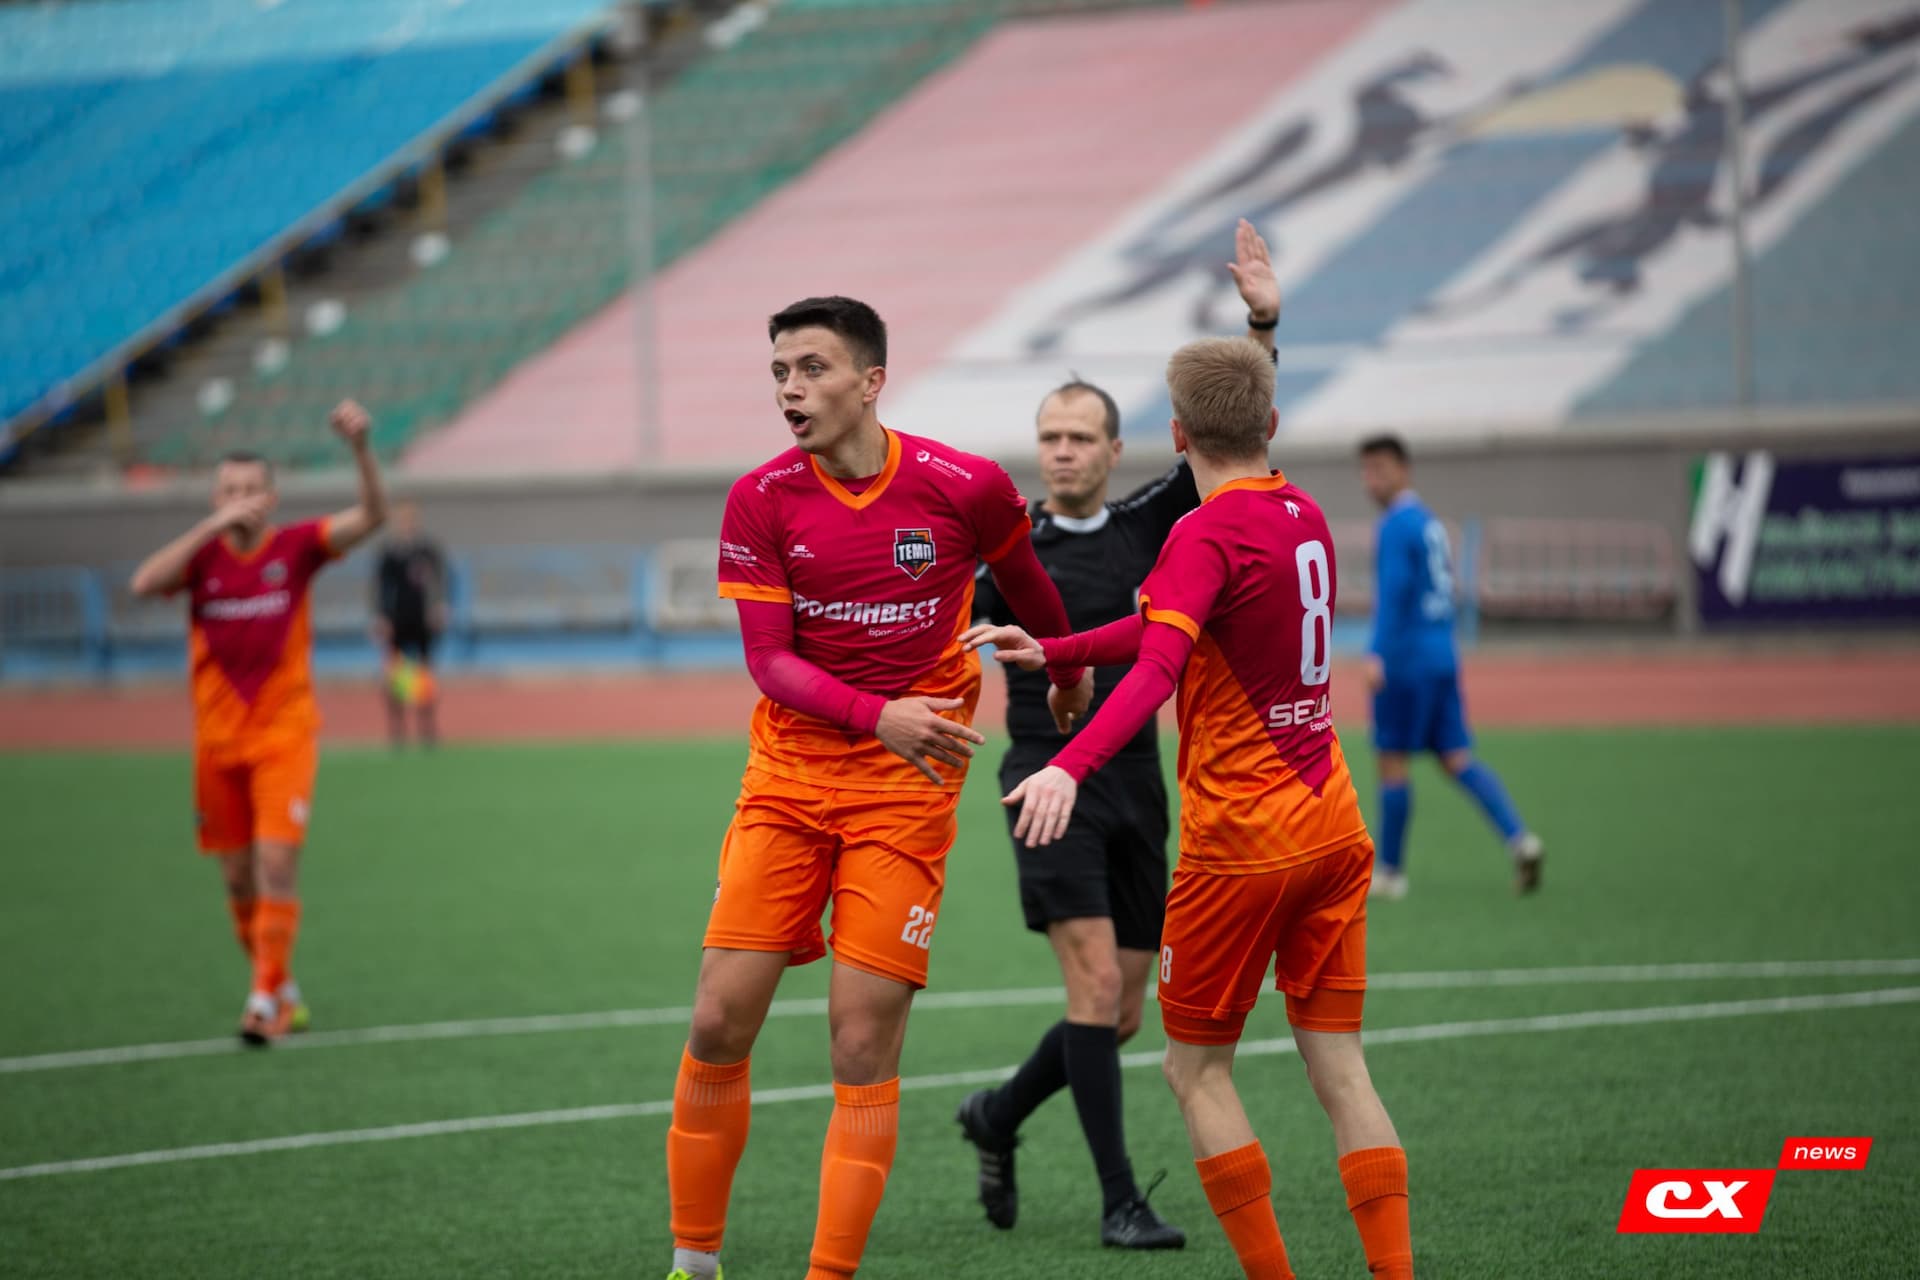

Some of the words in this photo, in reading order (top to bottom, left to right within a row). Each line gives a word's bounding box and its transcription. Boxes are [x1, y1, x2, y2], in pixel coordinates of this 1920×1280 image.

[898, 543, 932, 561] ТЕМП
[1295, 540, 1331, 686] 8
[901, 904, 934, 949] 22
[1161, 944, 1173, 984] 8
